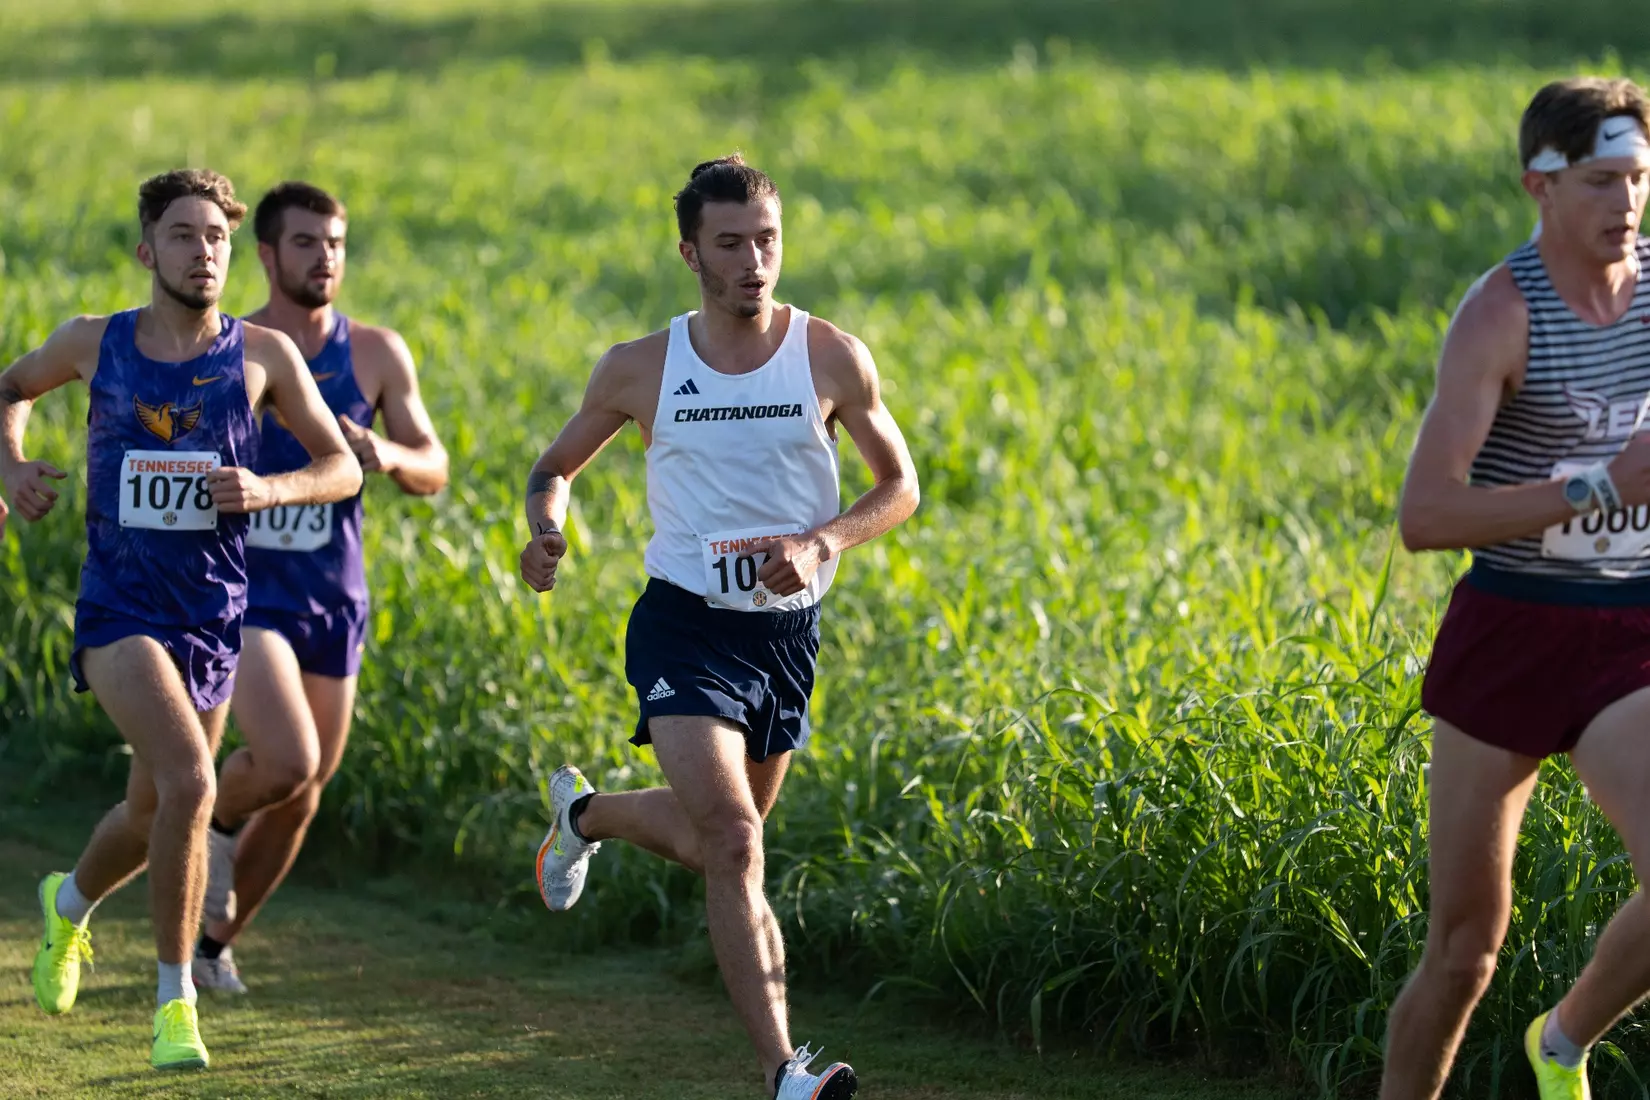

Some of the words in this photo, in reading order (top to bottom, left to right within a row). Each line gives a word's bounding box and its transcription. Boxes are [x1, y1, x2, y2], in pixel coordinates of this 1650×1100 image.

[674, 403, 803, 422] CHATTANOOGA
[129, 459, 213, 473] TENNESSEE
[127, 474, 213, 510] 1078
[646, 689, 676, 701] adidas
